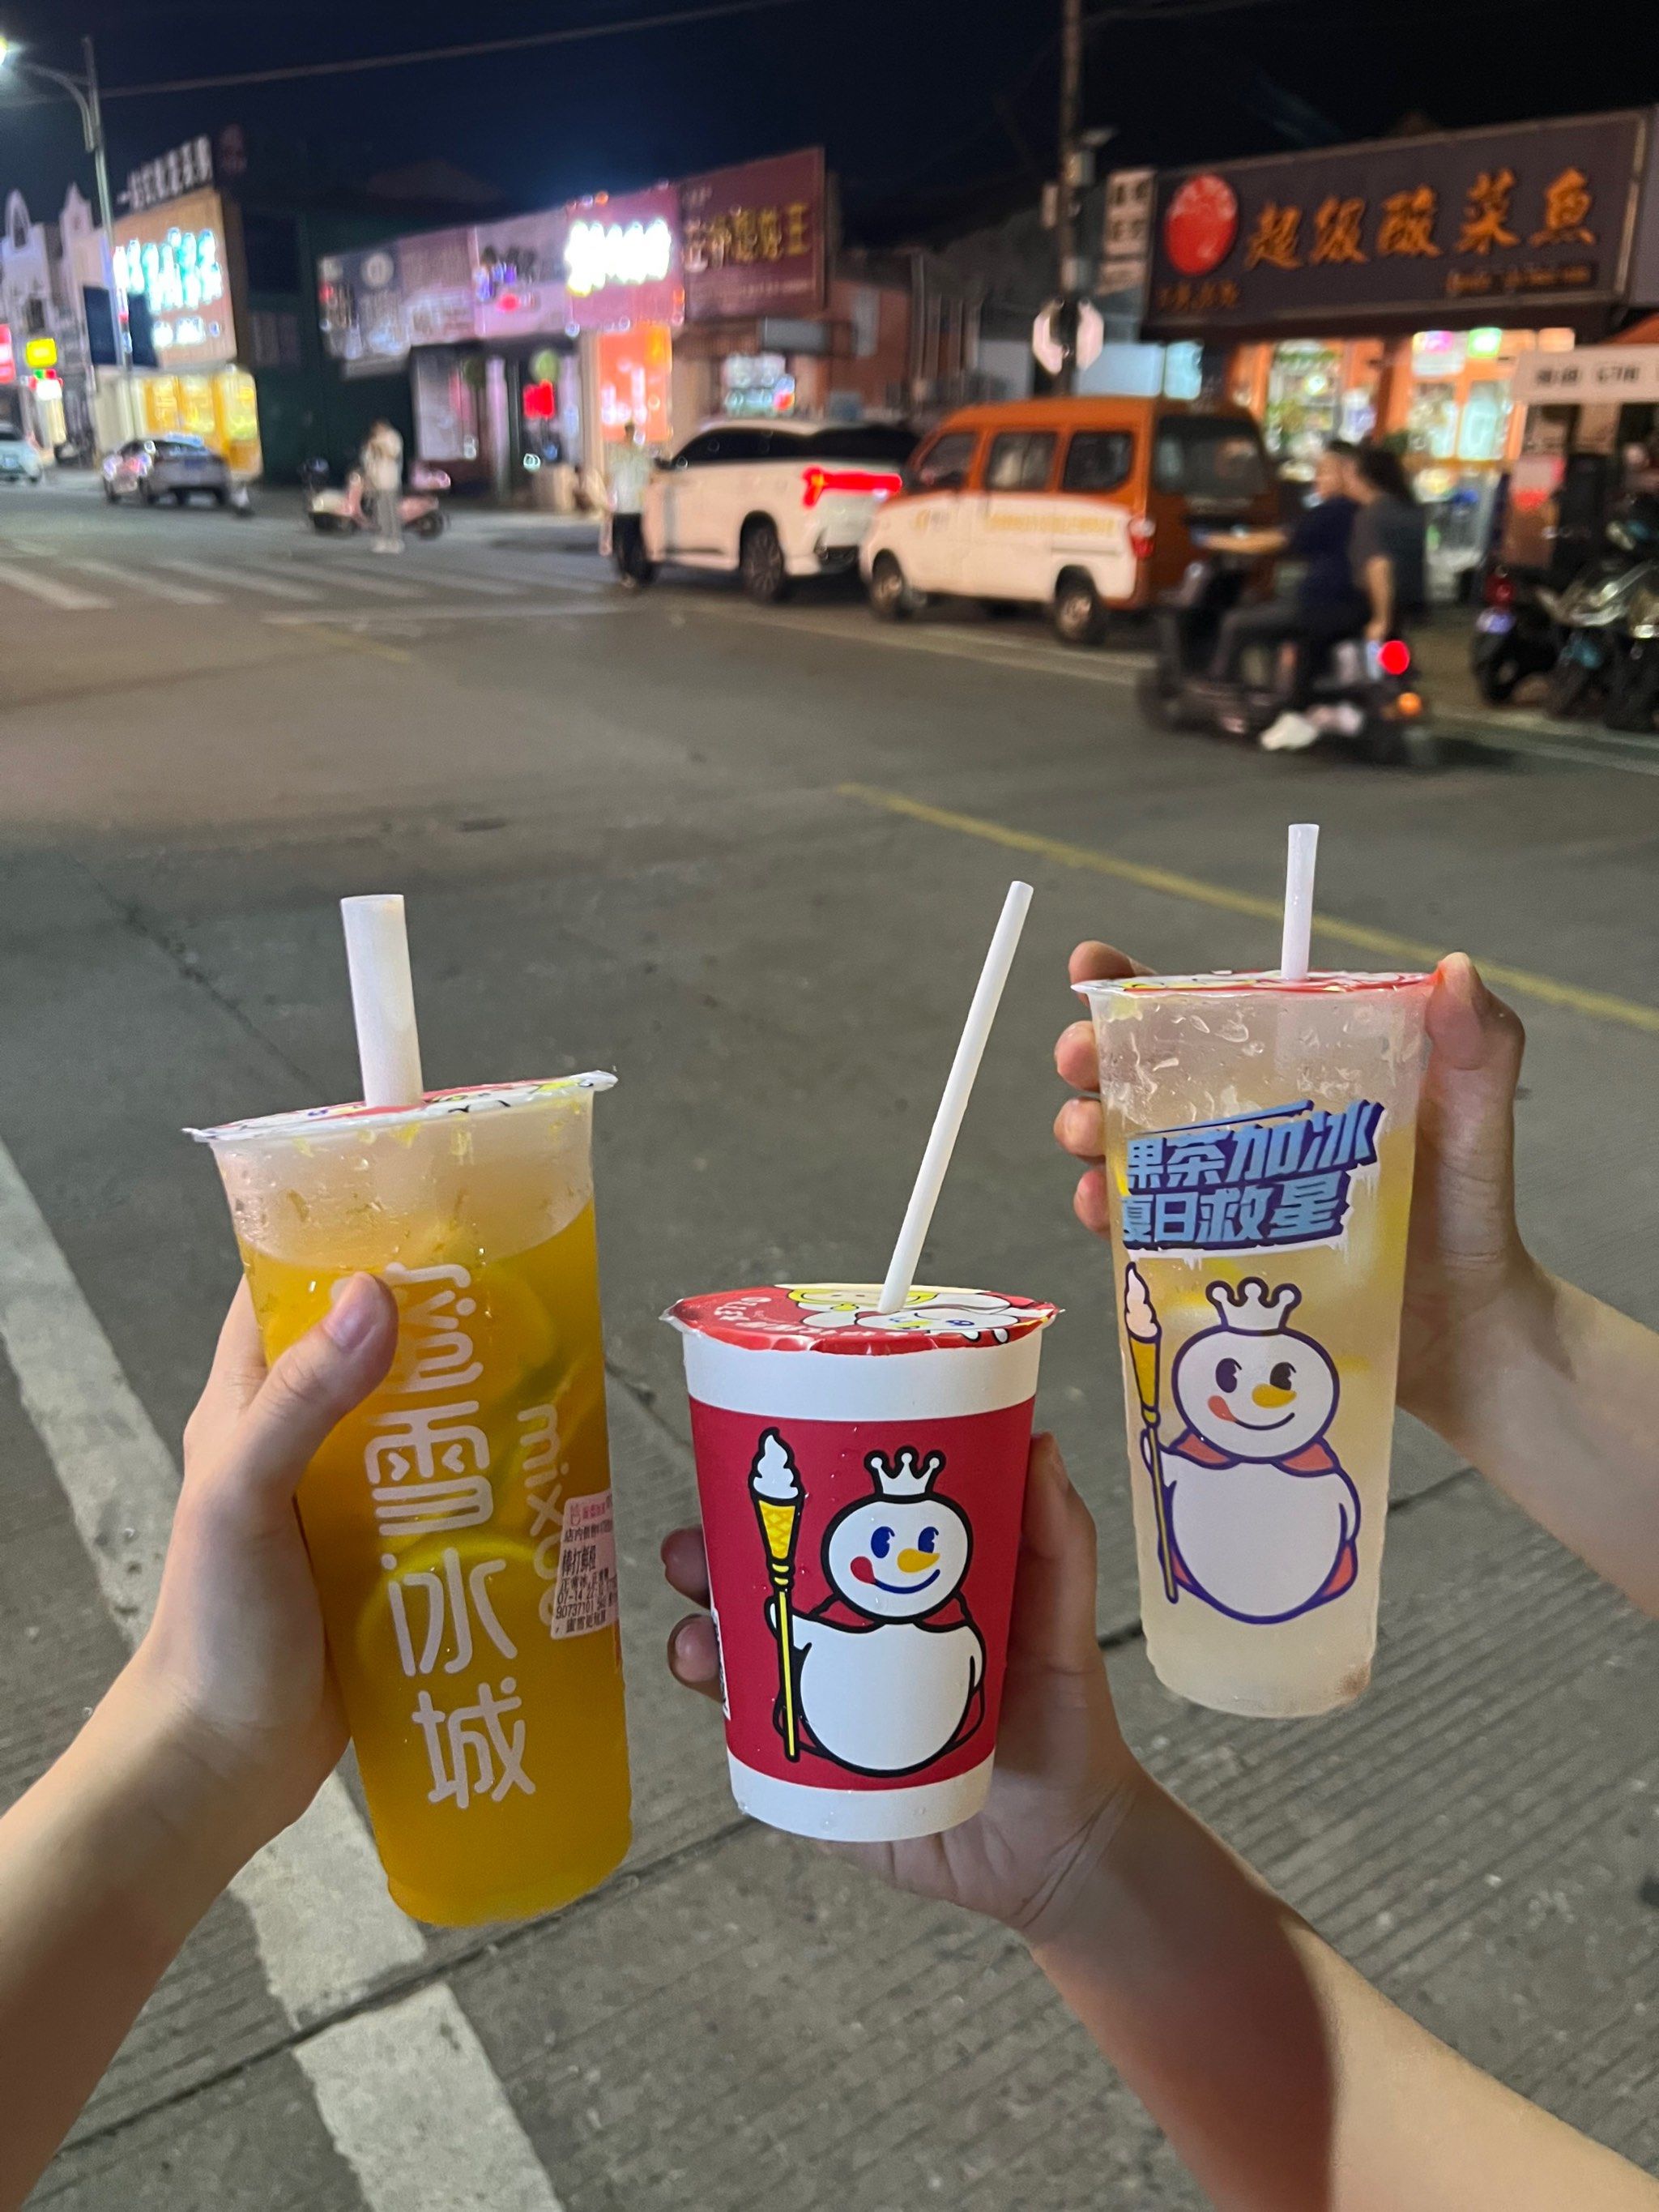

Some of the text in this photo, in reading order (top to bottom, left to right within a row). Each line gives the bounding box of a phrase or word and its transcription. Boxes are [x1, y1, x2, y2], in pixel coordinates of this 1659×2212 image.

[1127, 1100, 1384, 1194] 果茶加冰
[1121, 1171, 1349, 1250] 夏日救星
[332, 1261, 536, 1810] 蜜雪冰城
